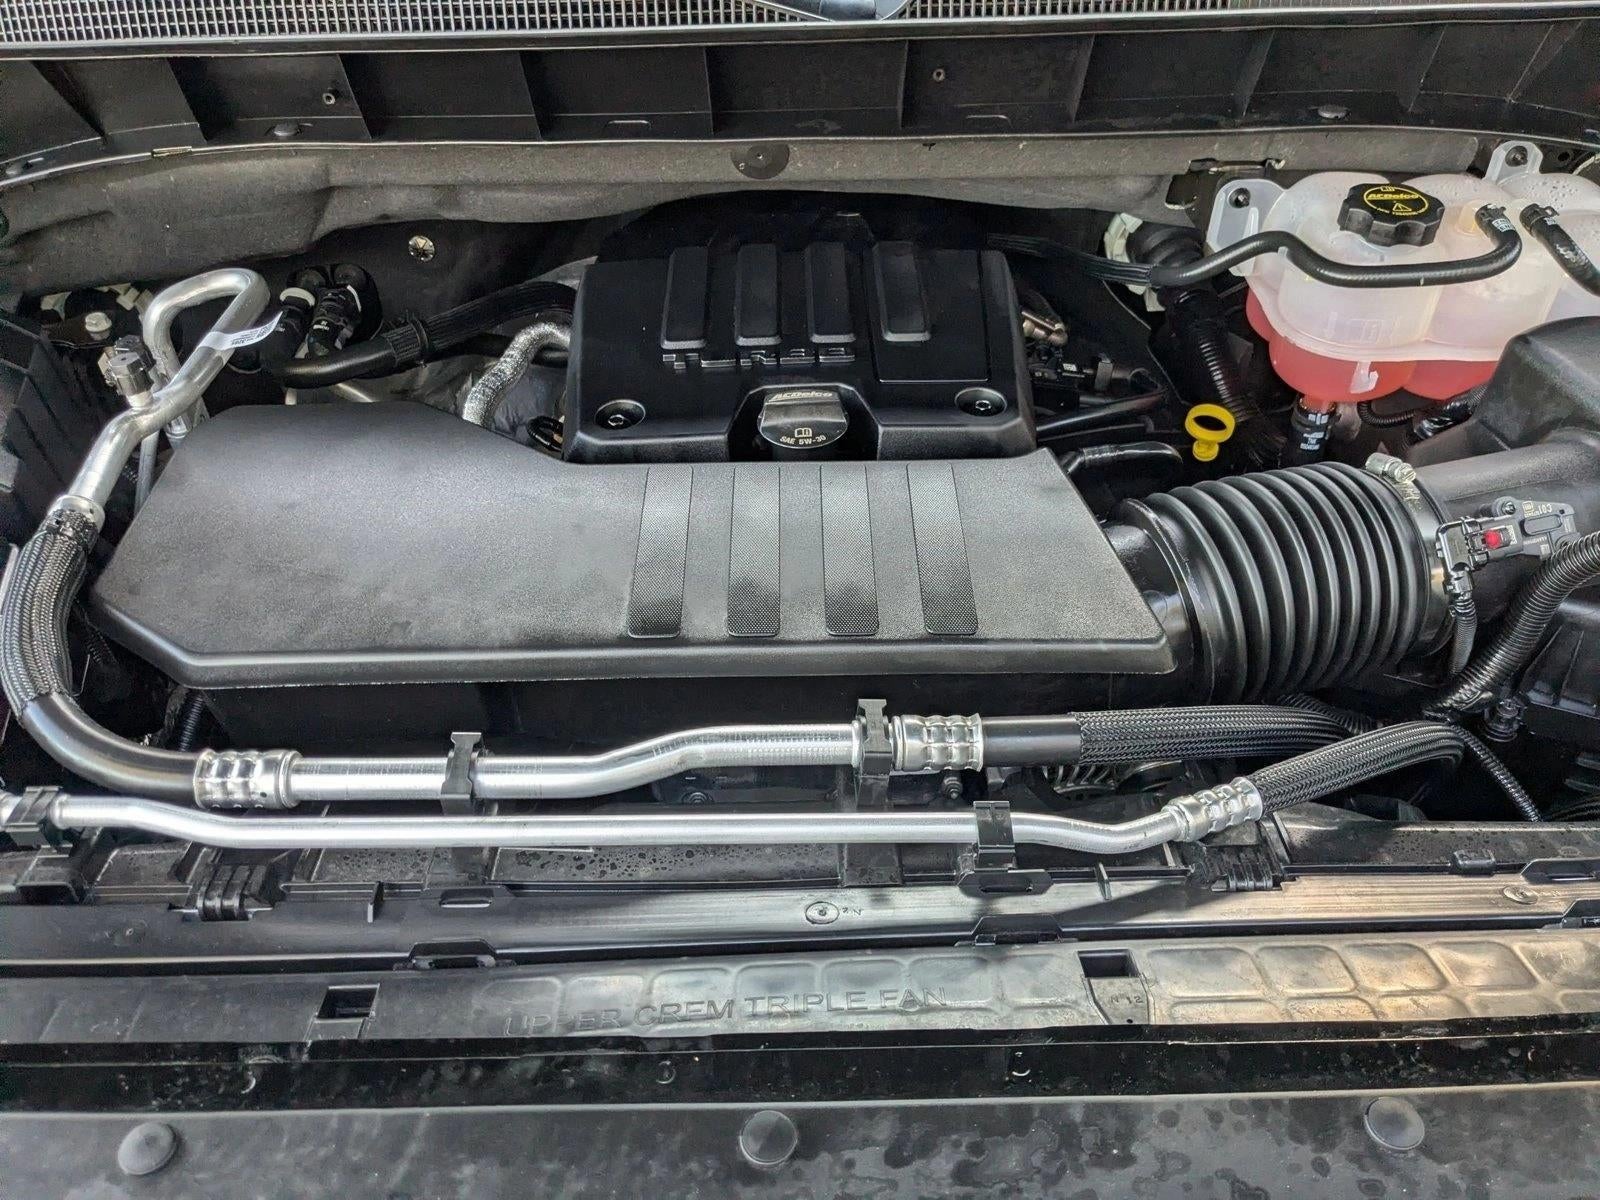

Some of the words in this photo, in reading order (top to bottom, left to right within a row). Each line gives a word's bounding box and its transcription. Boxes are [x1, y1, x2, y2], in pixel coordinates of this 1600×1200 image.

[780, 436, 796, 445] SAE
[799, 434, 827, 445] 5W-30
[503, 1009, 624, 1036] UPPER
[634, 1000, 734, 1026] CREM
[744, 991, 866, 1015] TRIPLE
[879, 987, 948, 1010] FAN
